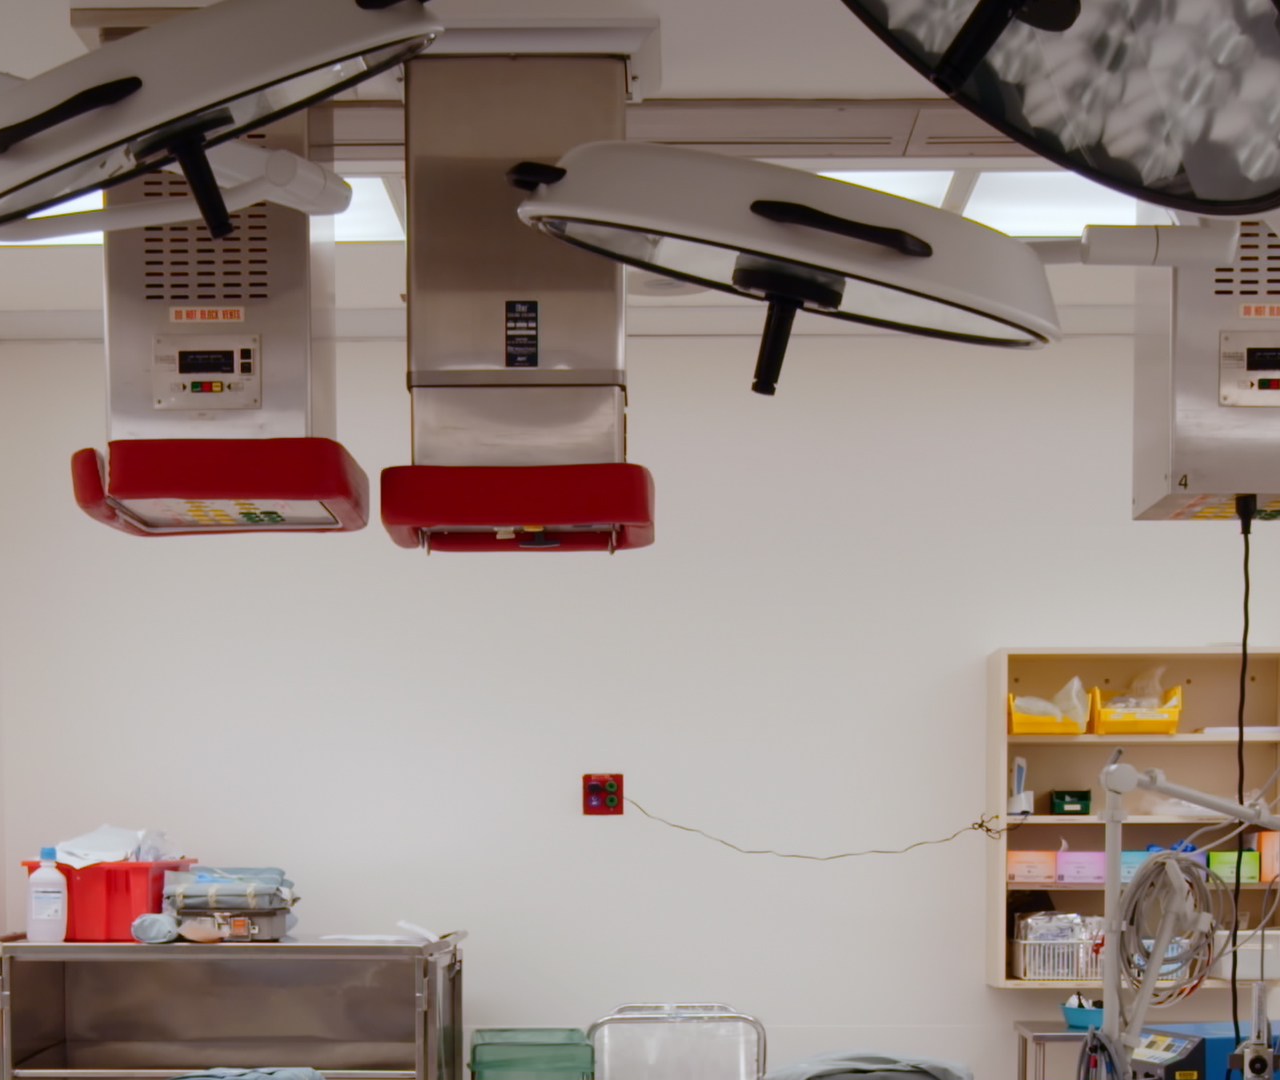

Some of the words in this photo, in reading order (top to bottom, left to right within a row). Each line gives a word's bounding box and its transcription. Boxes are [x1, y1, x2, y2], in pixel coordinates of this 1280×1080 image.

[174, 309, 183, 320] DO
[185, 309, 197, 320] NOT
[200, 309, 219, 320] BLOCK
[222, 309, 241, 320] VENTS
[1243, 305, 1252, 317] DO
[1254, 305, 1266, 317] NOT
[1178, 474, 1189, 490] 4
